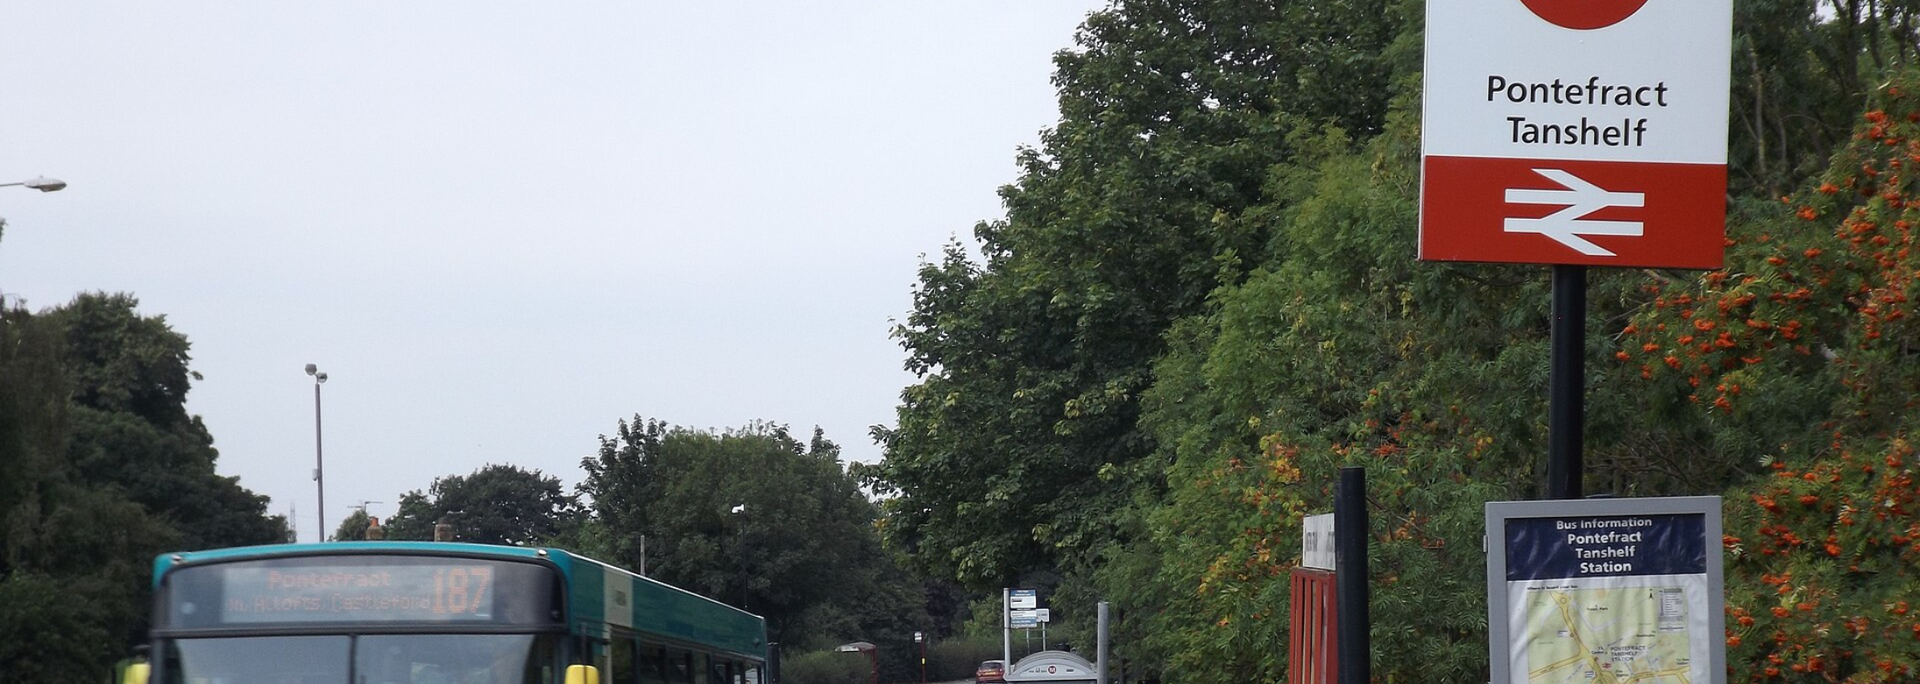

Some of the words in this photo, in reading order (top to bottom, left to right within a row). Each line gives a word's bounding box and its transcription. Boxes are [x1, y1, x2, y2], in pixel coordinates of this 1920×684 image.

[1487, 75, 1668, 107] Pontefract
[1506, 116, 1648, 147] Tanshelf
[1556, 520, 1577, 530] Bus
[1580, 517, 1652, 529] Information
[1567, 531, 1642, 545] Pontefract
[1575, 545, 1636, 559] Tanshelf
[1580, 561, 1632, 573] Station
[267, 570, 391, 590] Pontefract
[433, 567, 490, 614] 187
